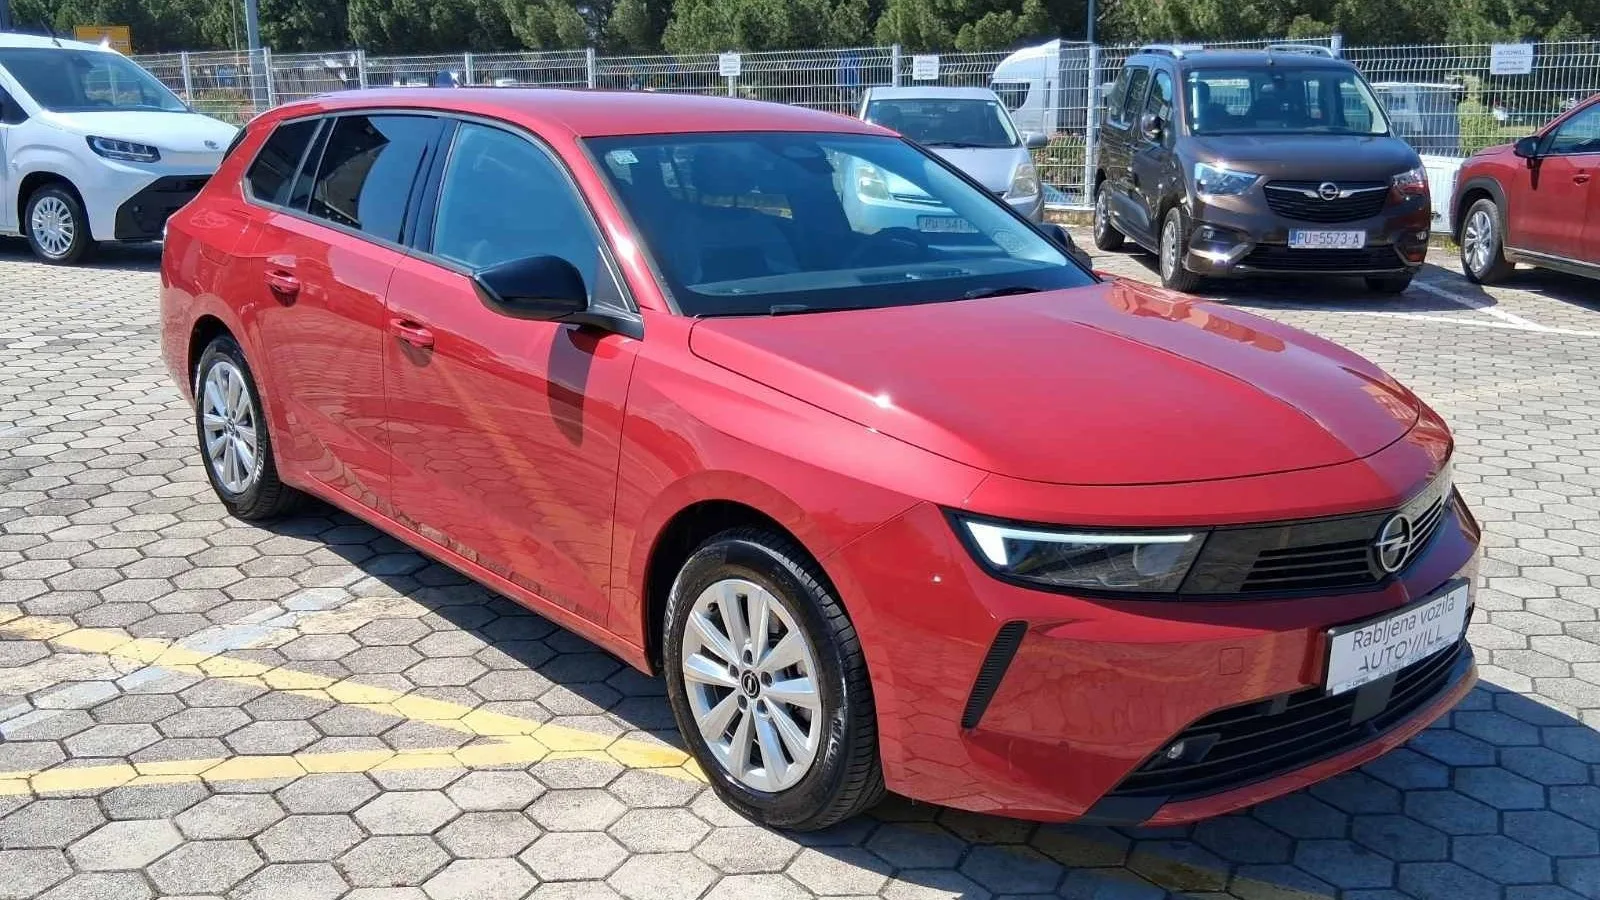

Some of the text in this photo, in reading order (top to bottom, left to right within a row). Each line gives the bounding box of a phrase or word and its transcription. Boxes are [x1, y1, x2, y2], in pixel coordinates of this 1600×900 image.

[1297, 232, 1311, 244] PU
[1352, 614, 1416, 652] Rabljena
[1420, 594, 1455, 624] vozila
